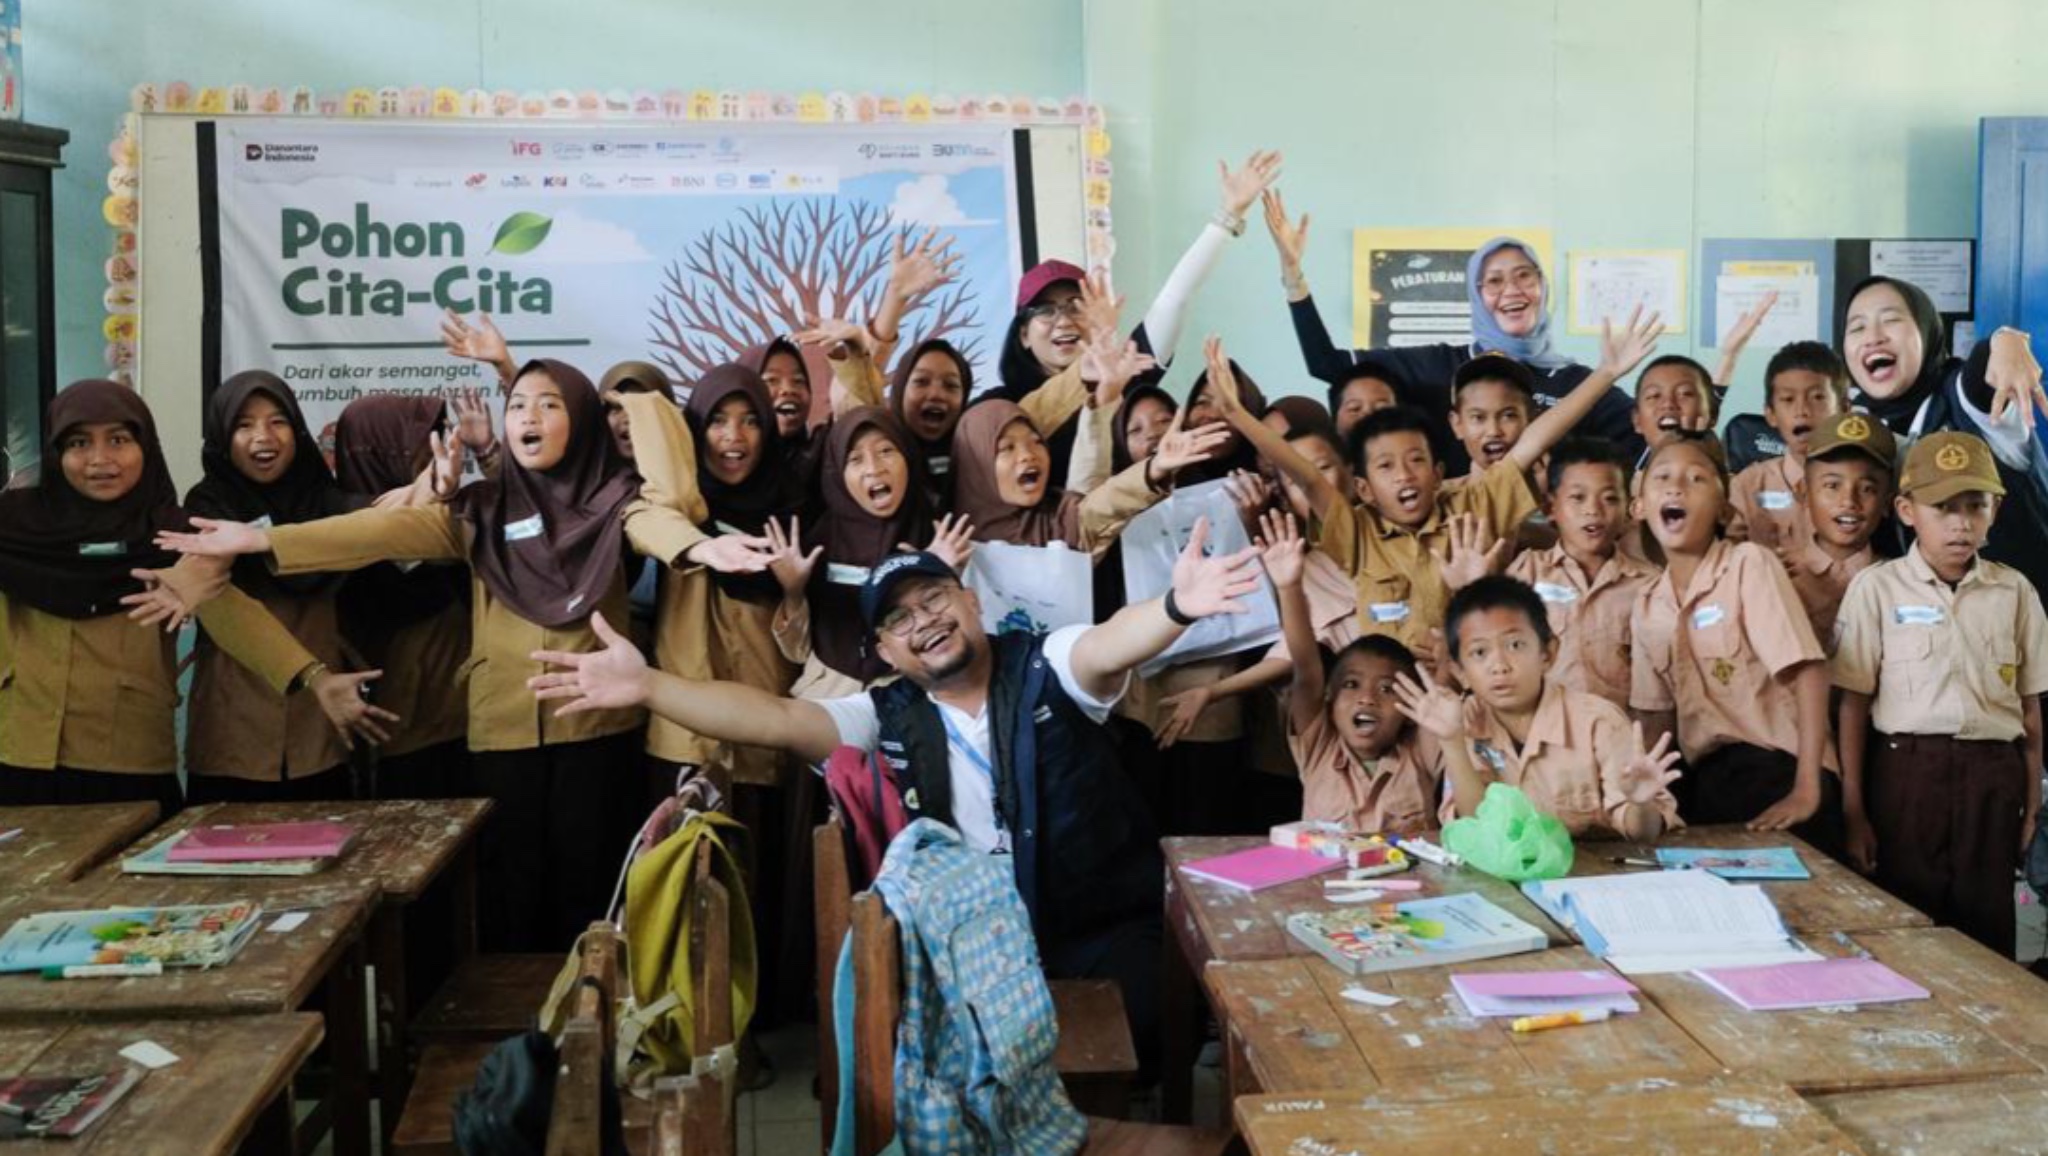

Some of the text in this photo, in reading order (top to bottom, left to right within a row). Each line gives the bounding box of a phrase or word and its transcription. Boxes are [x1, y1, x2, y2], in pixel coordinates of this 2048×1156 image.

[281, 203, 465, 259] Pohon
[1390, 271, 1465, 290] PERATURAN
[281, 266, 552, 316] Cita-Cita
[284, 364, 482, 381] Dari akar semangat,
[294, 385, 363, 401] umbuh
